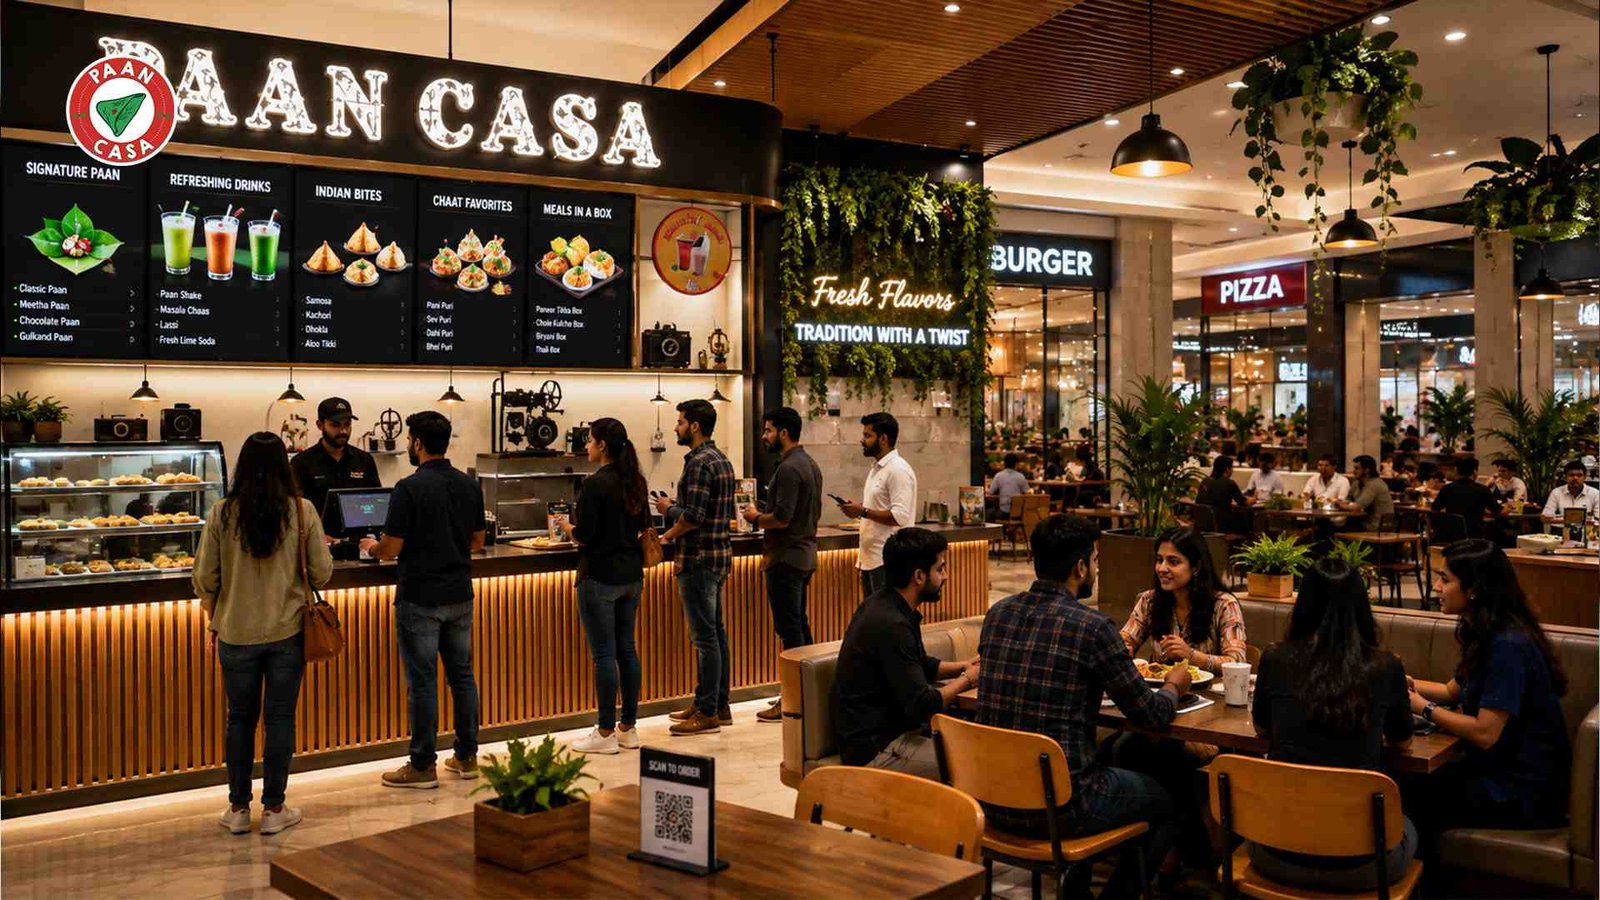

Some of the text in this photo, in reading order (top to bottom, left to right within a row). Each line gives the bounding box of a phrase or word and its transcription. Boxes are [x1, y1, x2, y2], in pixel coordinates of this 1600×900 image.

[418, 78, 661, 168] CASA
[26, 162, 120, 181] SIGNATURE PAAN
[170, 173, 271, 193] REFRESHING DRINKS
[315, 185, 382, 201] INDIAN BITES
[433, 195, 513, 212] CHAAT FAVORITES
[543, 203, 612, 219] MEALS IN A BOX
[991, 246, 1093, 276] BURGER
[19, 283, 67, 294] Classic Paan
[160, 289, 202, 300] Paan Shake
[811, 276, 957, 312] Fresh Flavors
[1220, 274, 1284, 304] PIZZA
[20, 300, 70, 310] Meetha Paan
[306, 295, 332, 305] Samosa
[160, 305, 186, 314] Masala
[20, 316, 80, 326] Chocolate Paan
[160, 320, 179, 329] Lassi
[53, 333, 73, 342] Paan
[160, 335, 216, 346] Fresh Lime Soda
[795, 323, 970, 346] TRADITION WITH A TWIST
[649, 760, 667, 773] SCAN
[668, 763, 677, 774] TO
